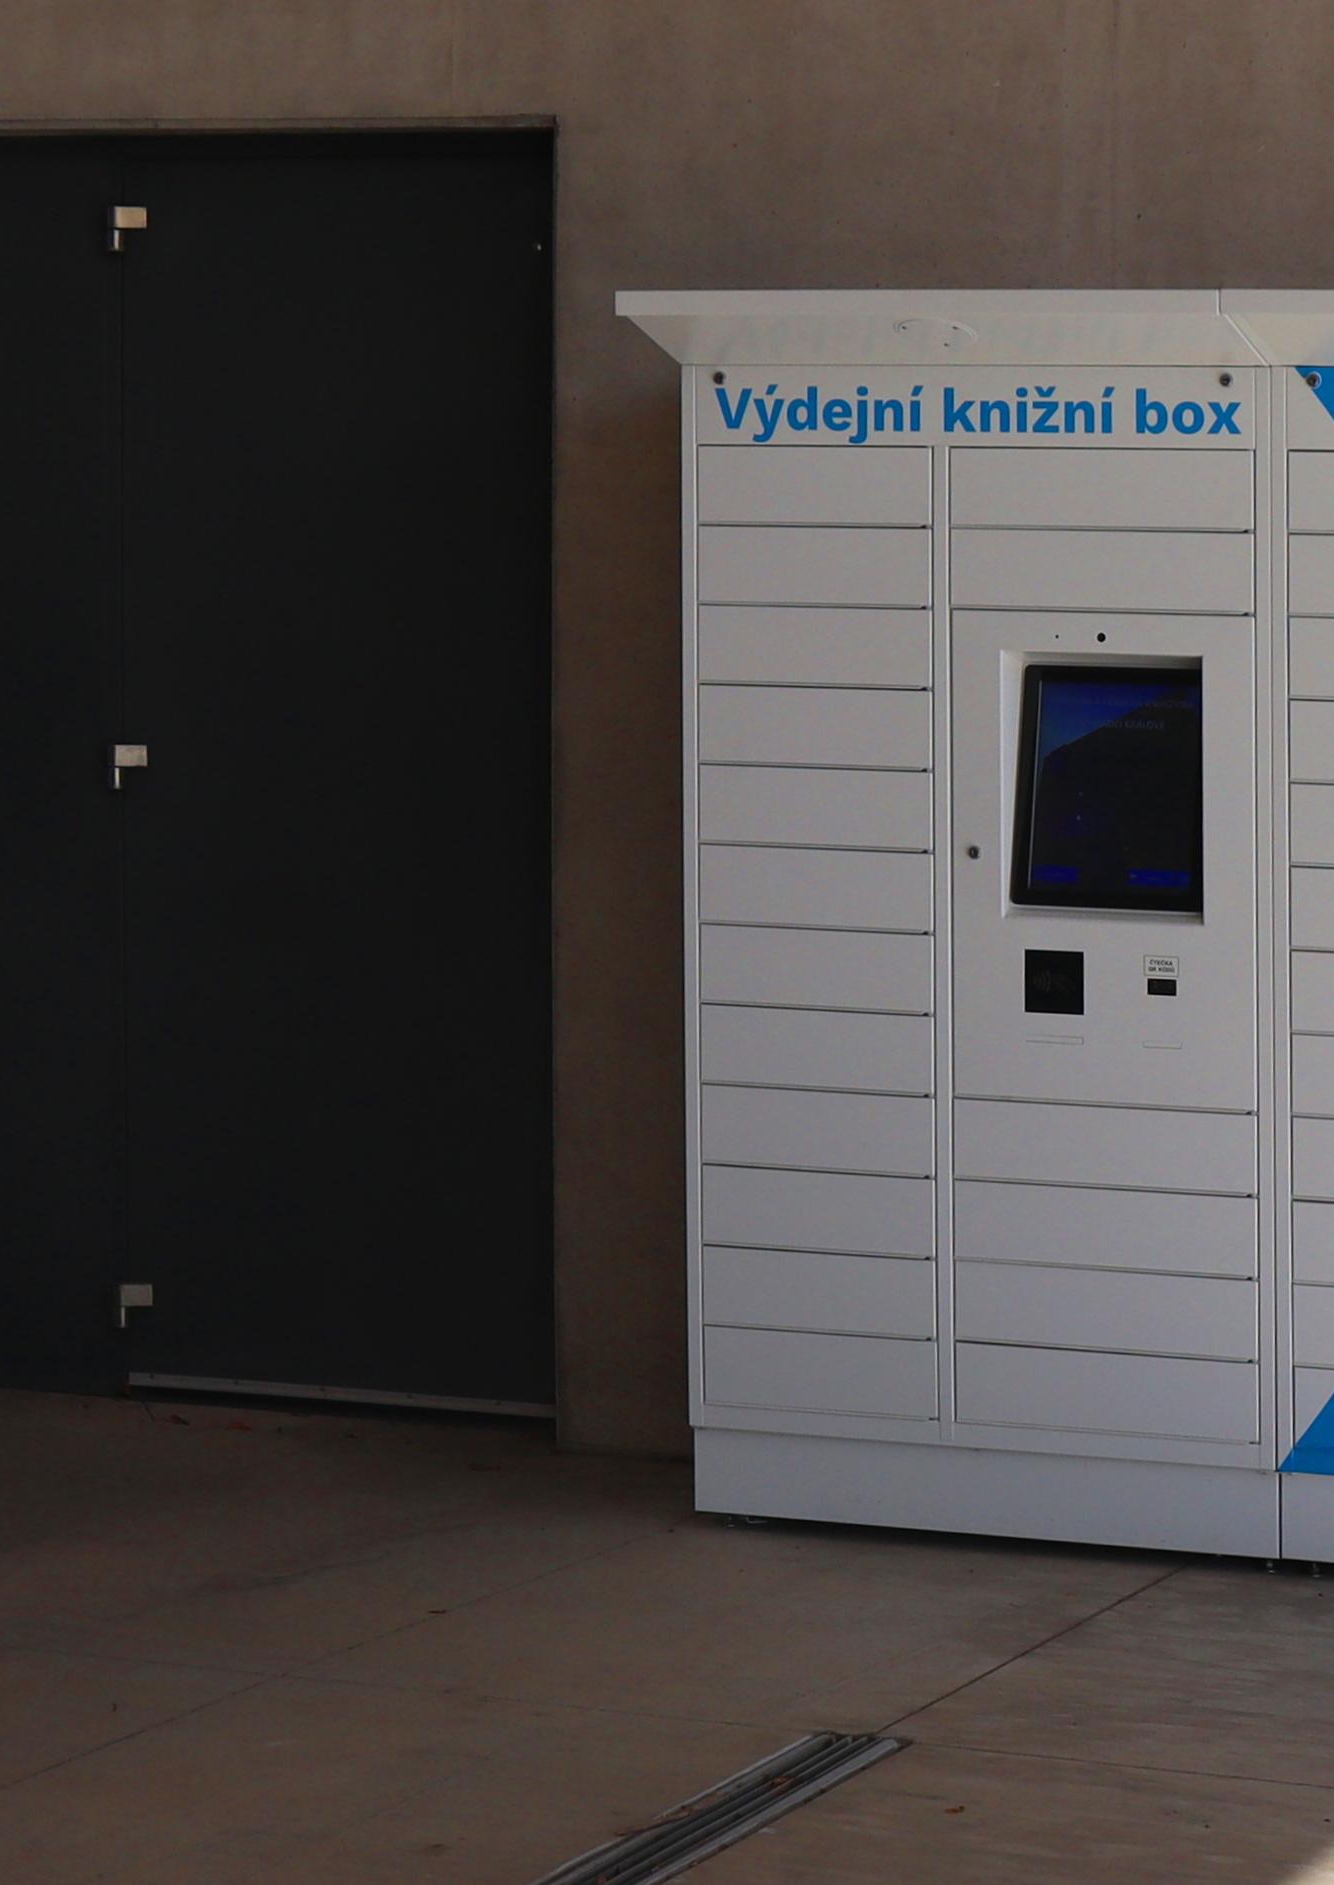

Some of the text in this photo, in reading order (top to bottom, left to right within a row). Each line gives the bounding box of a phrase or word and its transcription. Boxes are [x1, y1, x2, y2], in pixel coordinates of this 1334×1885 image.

[716, 385, 1241, 443] Výdejní knižní box
